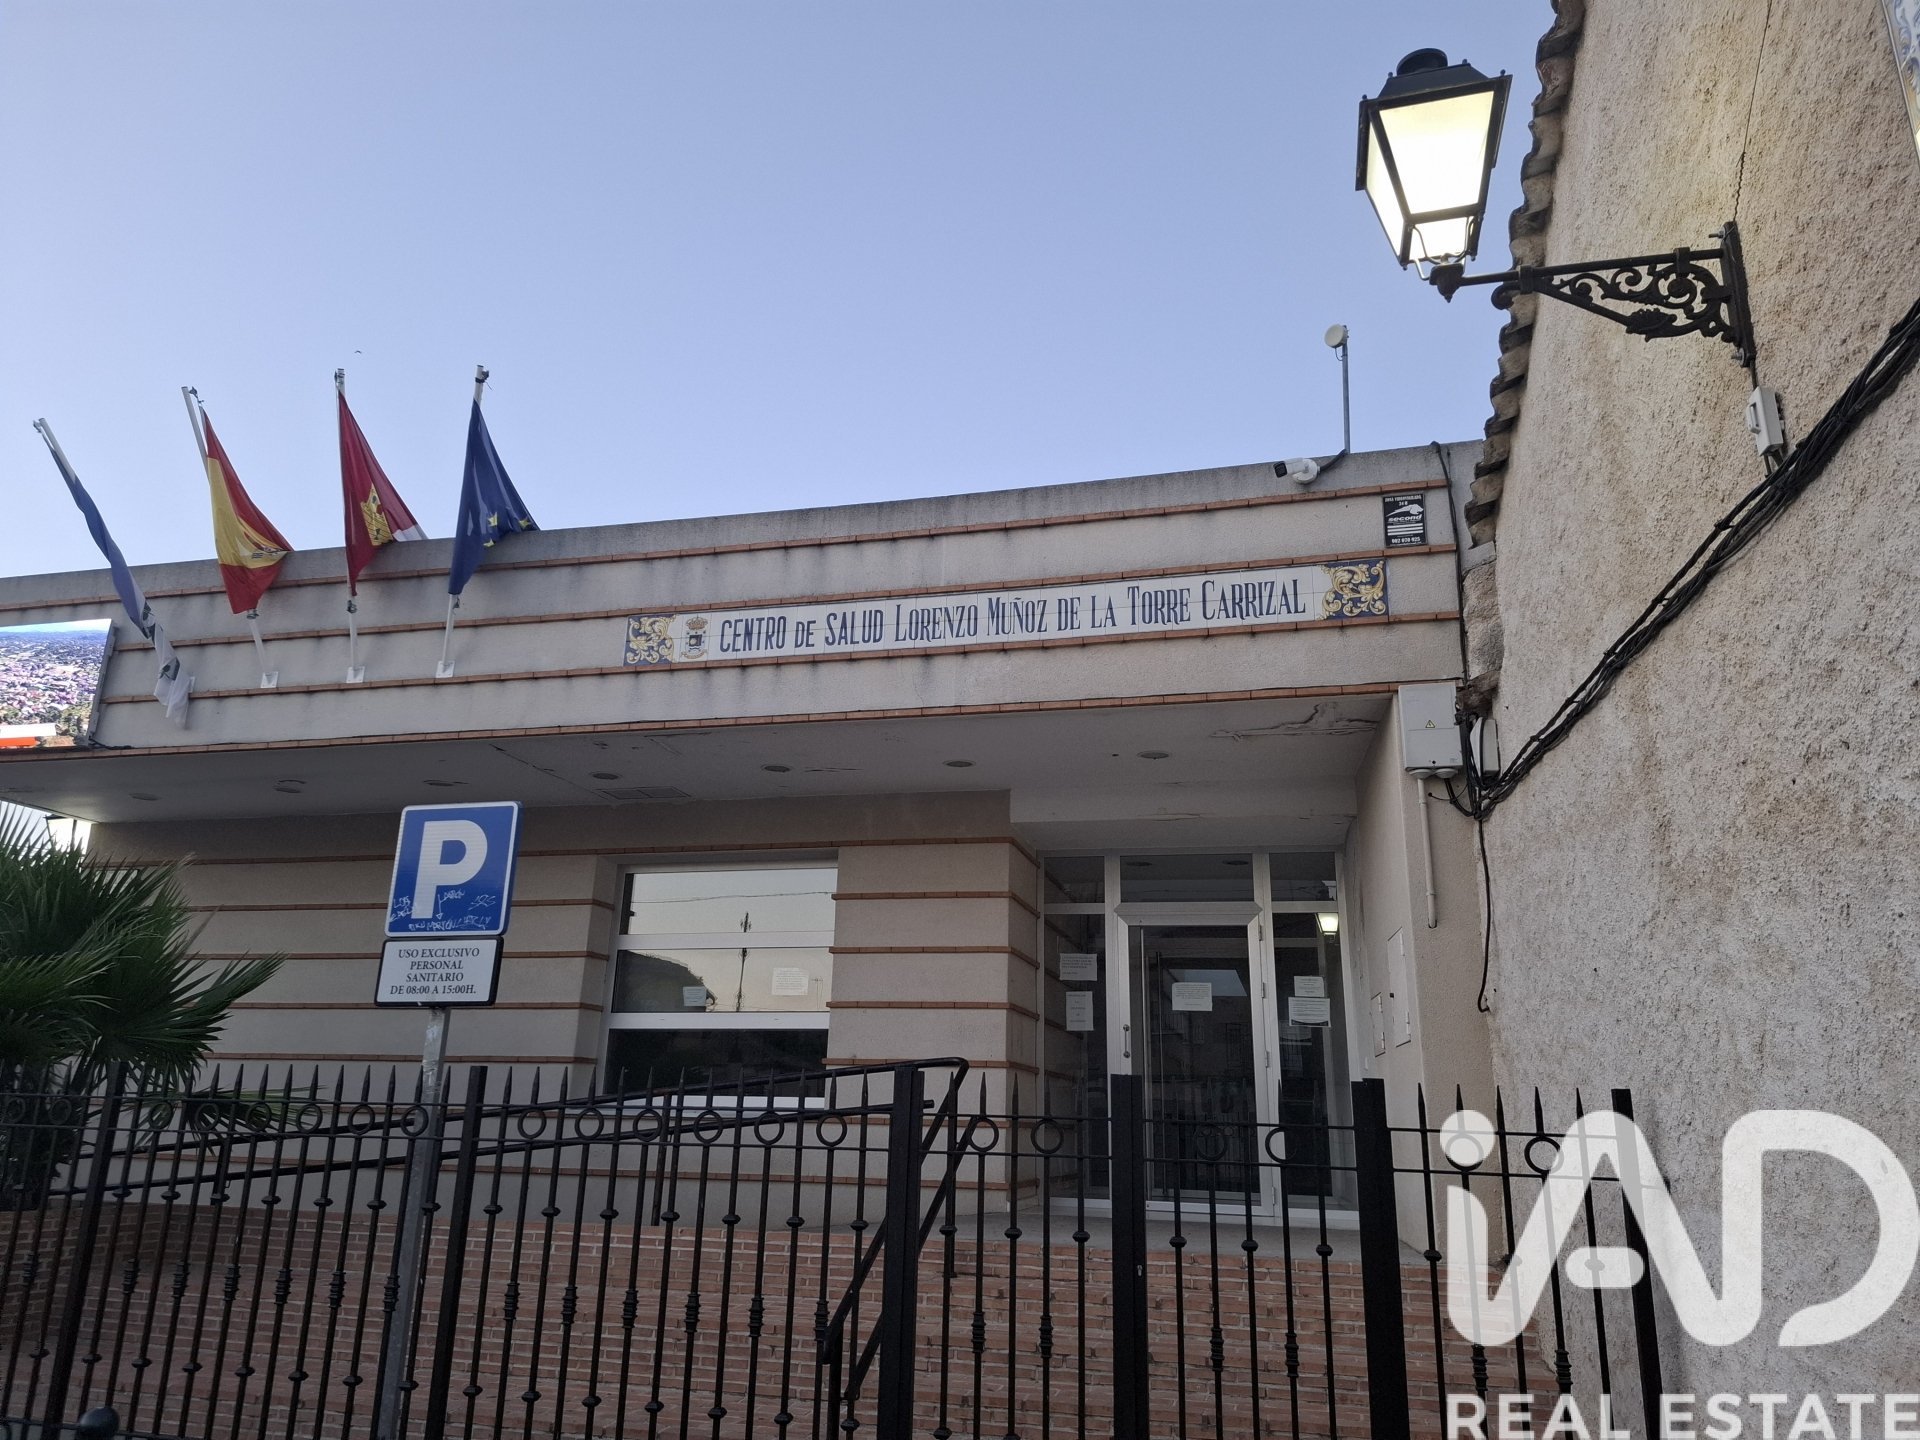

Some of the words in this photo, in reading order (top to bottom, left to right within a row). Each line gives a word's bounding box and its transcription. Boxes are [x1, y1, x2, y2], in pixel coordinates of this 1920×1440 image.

[719, 615, 787, 653] CENTRO
[794, 619, 817, 648] DE
[824, 608, 884, 646] SALUD
[894, 603, 978, 643] LORENZO
[987, 597, 1048, 636] MUÑOZ
[1057, 596, 1081, 632] DE
[1091, 595, 1118, 628] LA
[1127, 585, 1191, 626] TORRE
[1201, 578, 1306, 621] CARRIZAL
[411, 819, 488, 919] P
[398, 948, 419, 959] USO
[421, 947, 480, 959] EXCLUSIVO
[410, 960, 464, 970] PERSONAL
[406, 972, 464, 983] SANITARIO
[390, 985, 404, 995] DE
[406, 985, 430, 995] 08:00
[433, 985, 439, 994] A
[442, 984, 477, 994] 15:00H.
